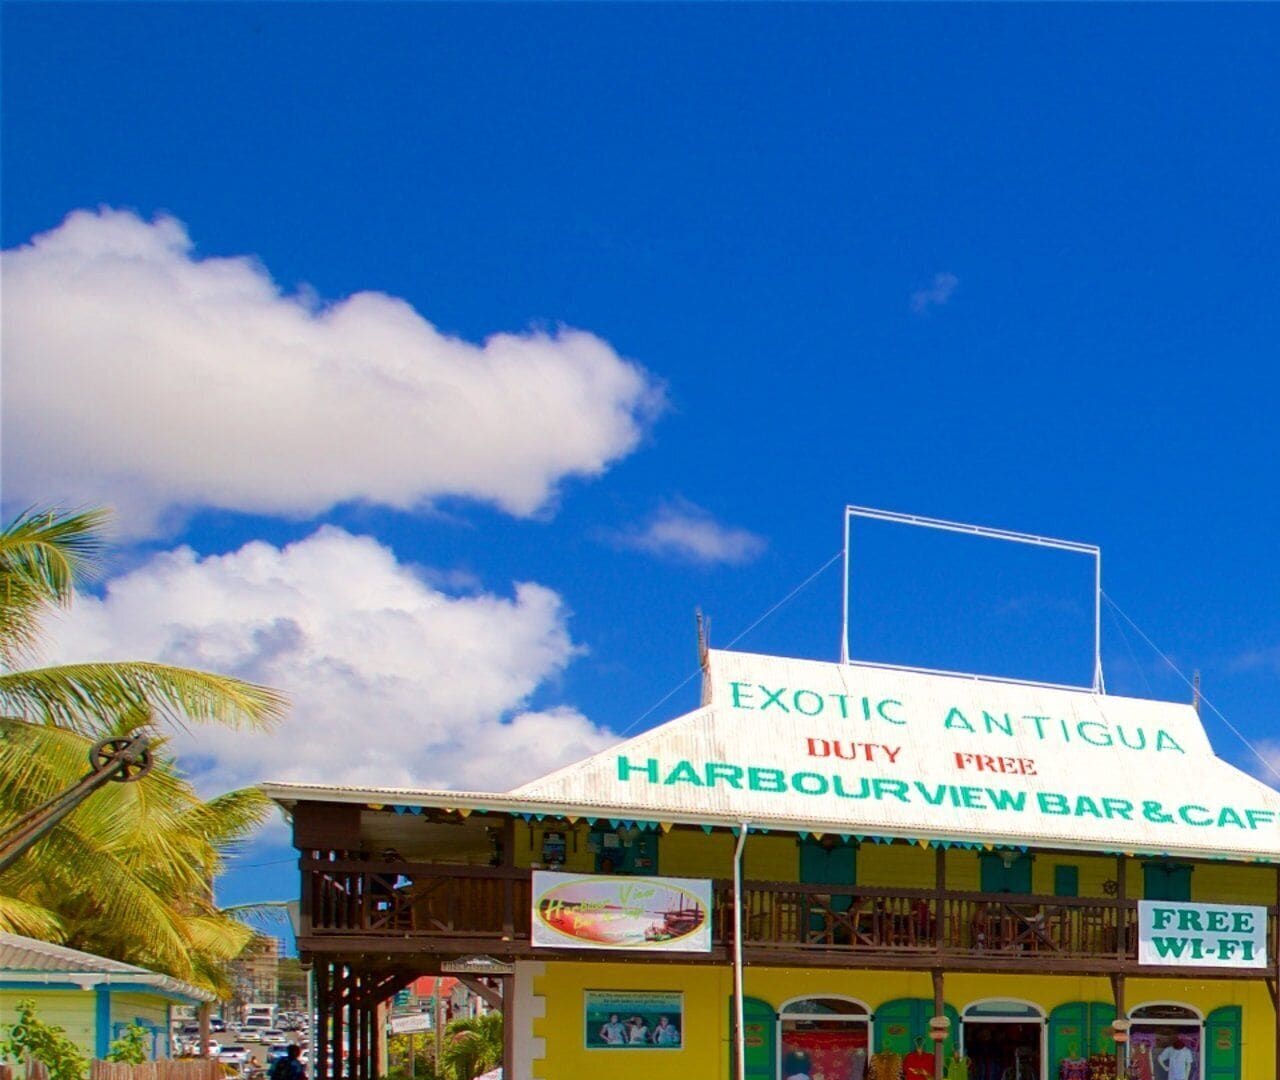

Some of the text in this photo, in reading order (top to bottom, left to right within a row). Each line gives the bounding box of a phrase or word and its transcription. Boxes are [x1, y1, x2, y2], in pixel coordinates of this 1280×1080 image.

[729, 681, 1186, 754] EXOTIC ANTIGUA
[806, 737, 1038, 777] DUTY FREE
[1152, 908, 1255, 933] FREE
[1151, 936, 1255, 961] WI-FI
